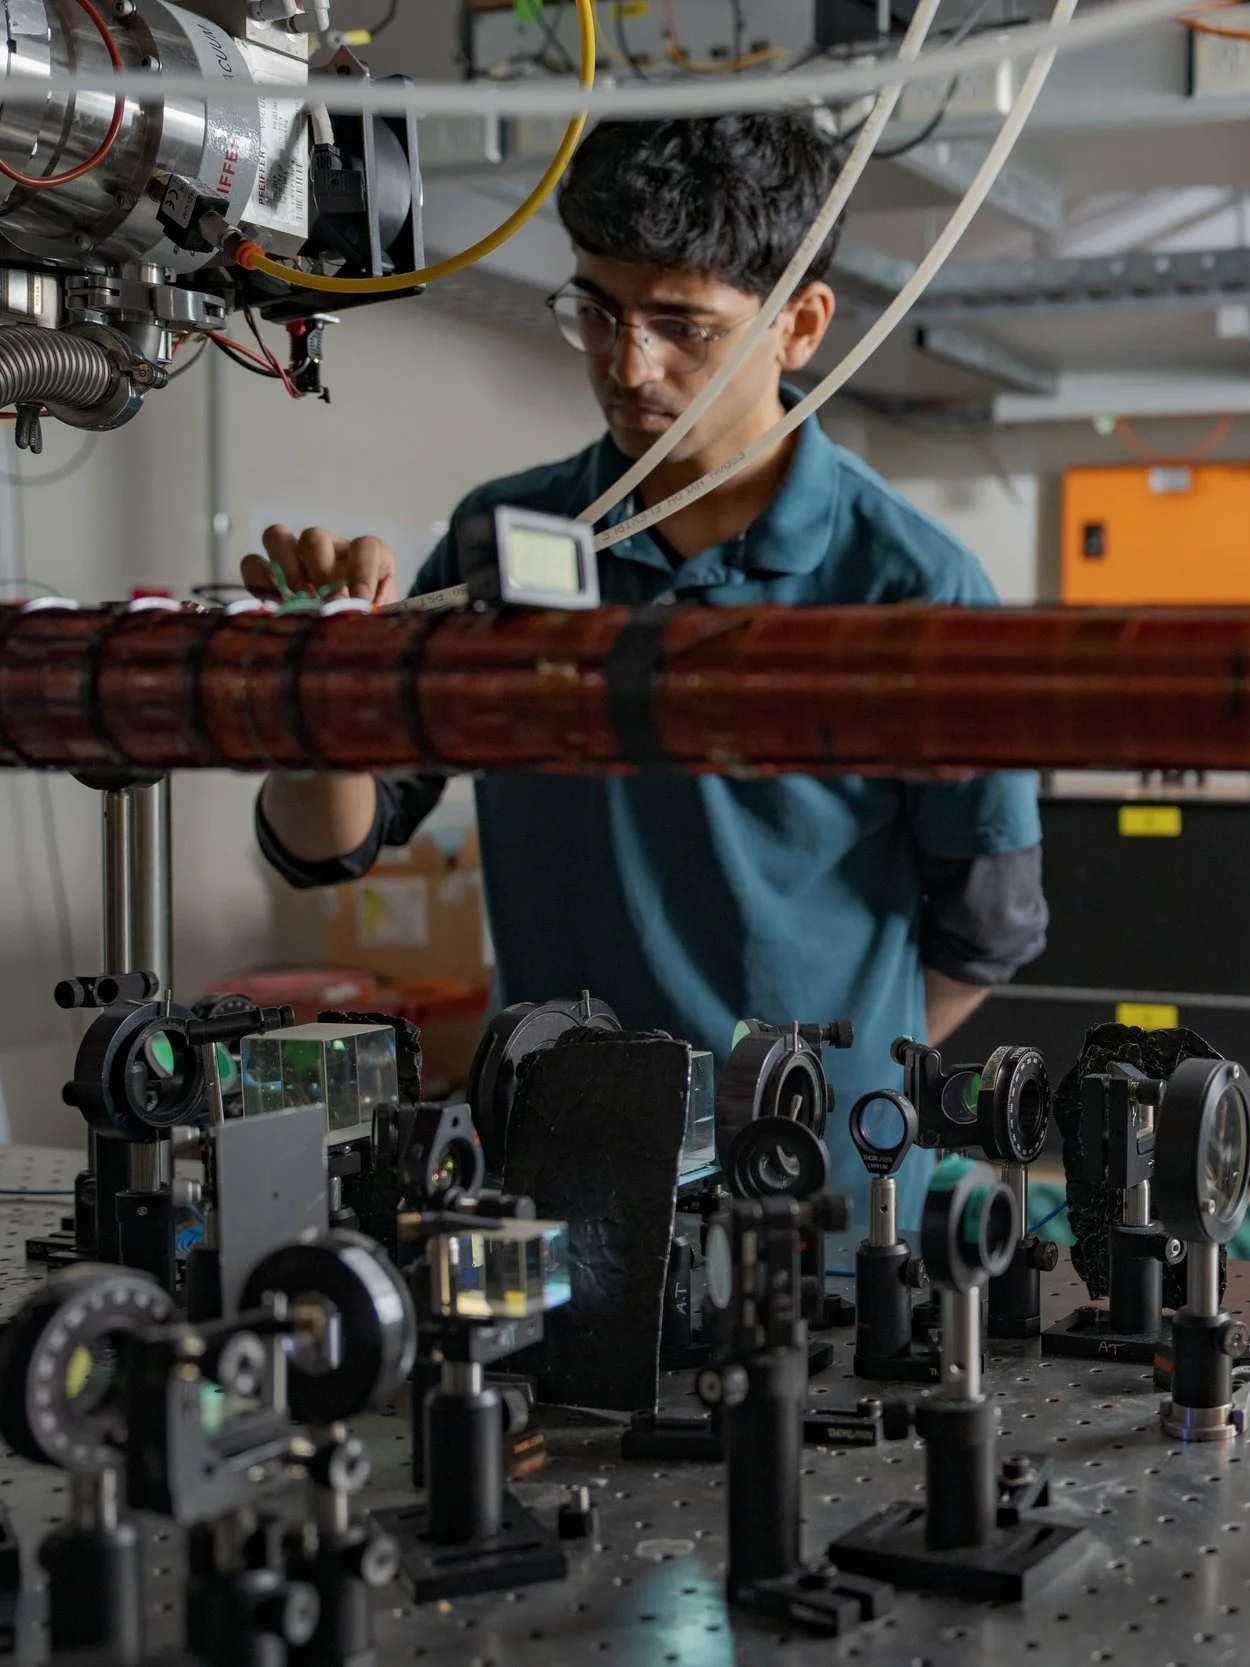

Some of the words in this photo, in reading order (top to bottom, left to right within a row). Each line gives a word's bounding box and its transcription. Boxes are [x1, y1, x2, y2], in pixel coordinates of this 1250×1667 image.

[196, 23, 235, 81] ACUUM
[216, 136, 240, 196] IFFER
[258, 150, 267, 206] PFEIFFER
[601, 505, 662, 541] FLEXIBLE
[1098, 1339, 1126, 1356] AT
